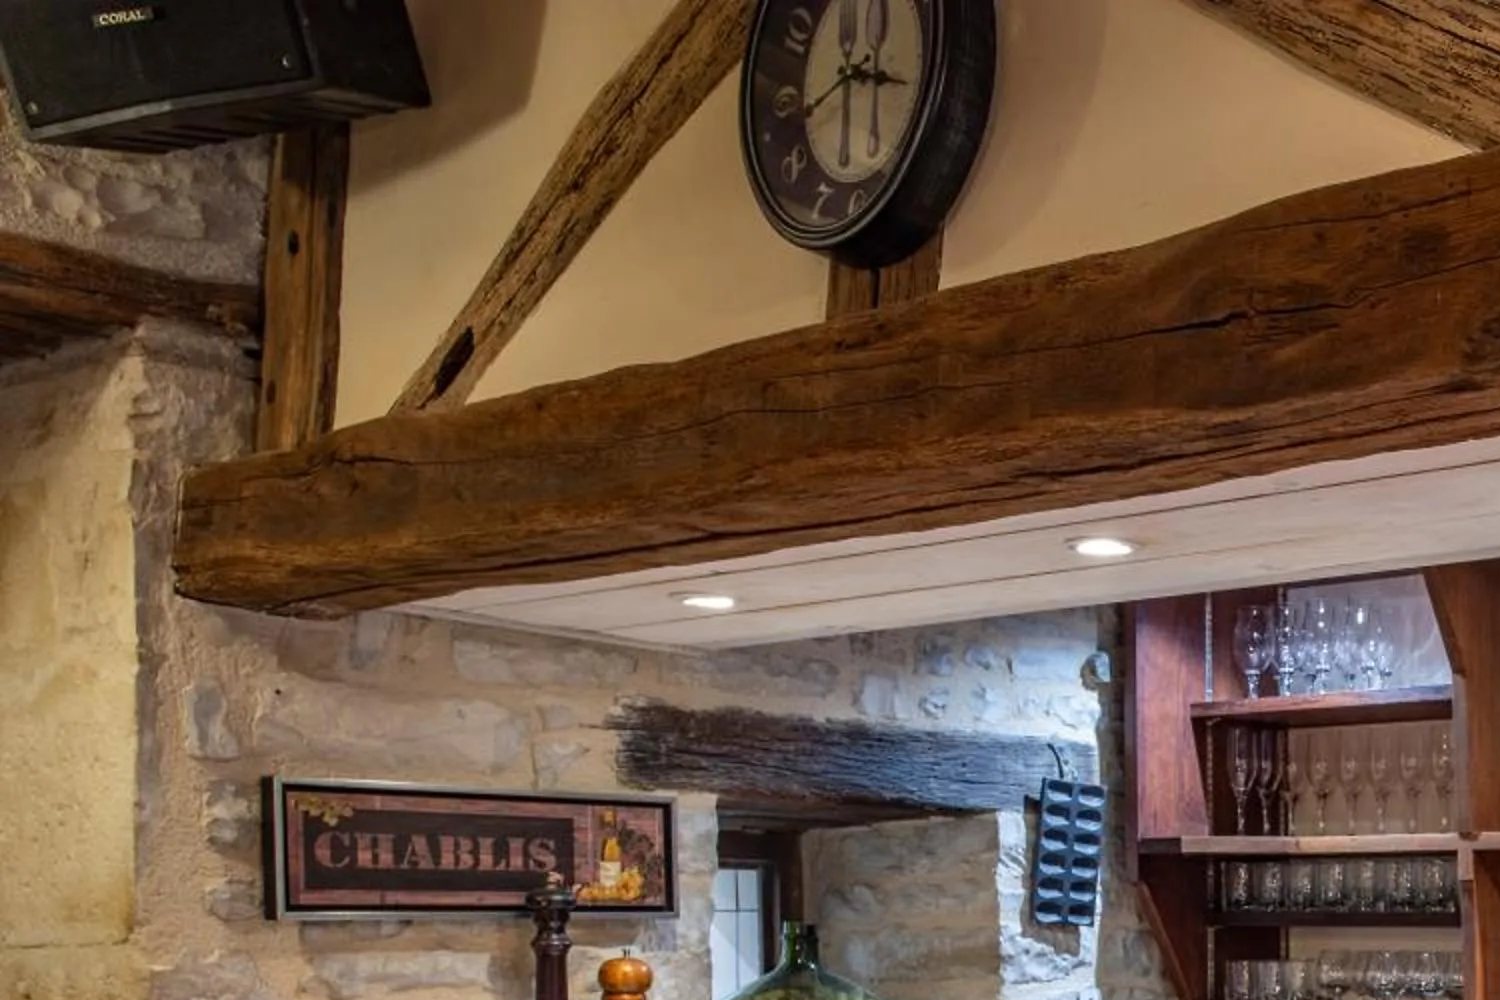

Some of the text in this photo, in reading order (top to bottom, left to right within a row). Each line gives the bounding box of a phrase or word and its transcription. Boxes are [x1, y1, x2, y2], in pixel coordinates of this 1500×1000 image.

[99, 9, 145, 26] CORAL
[784, 8, 814, 54] 10
[773, 86, 799, 118] 9
[782, 144, 807, 184] 8
[812, 182, 835, 219] 7
[313, 830, 558, 872] CHABLIS
